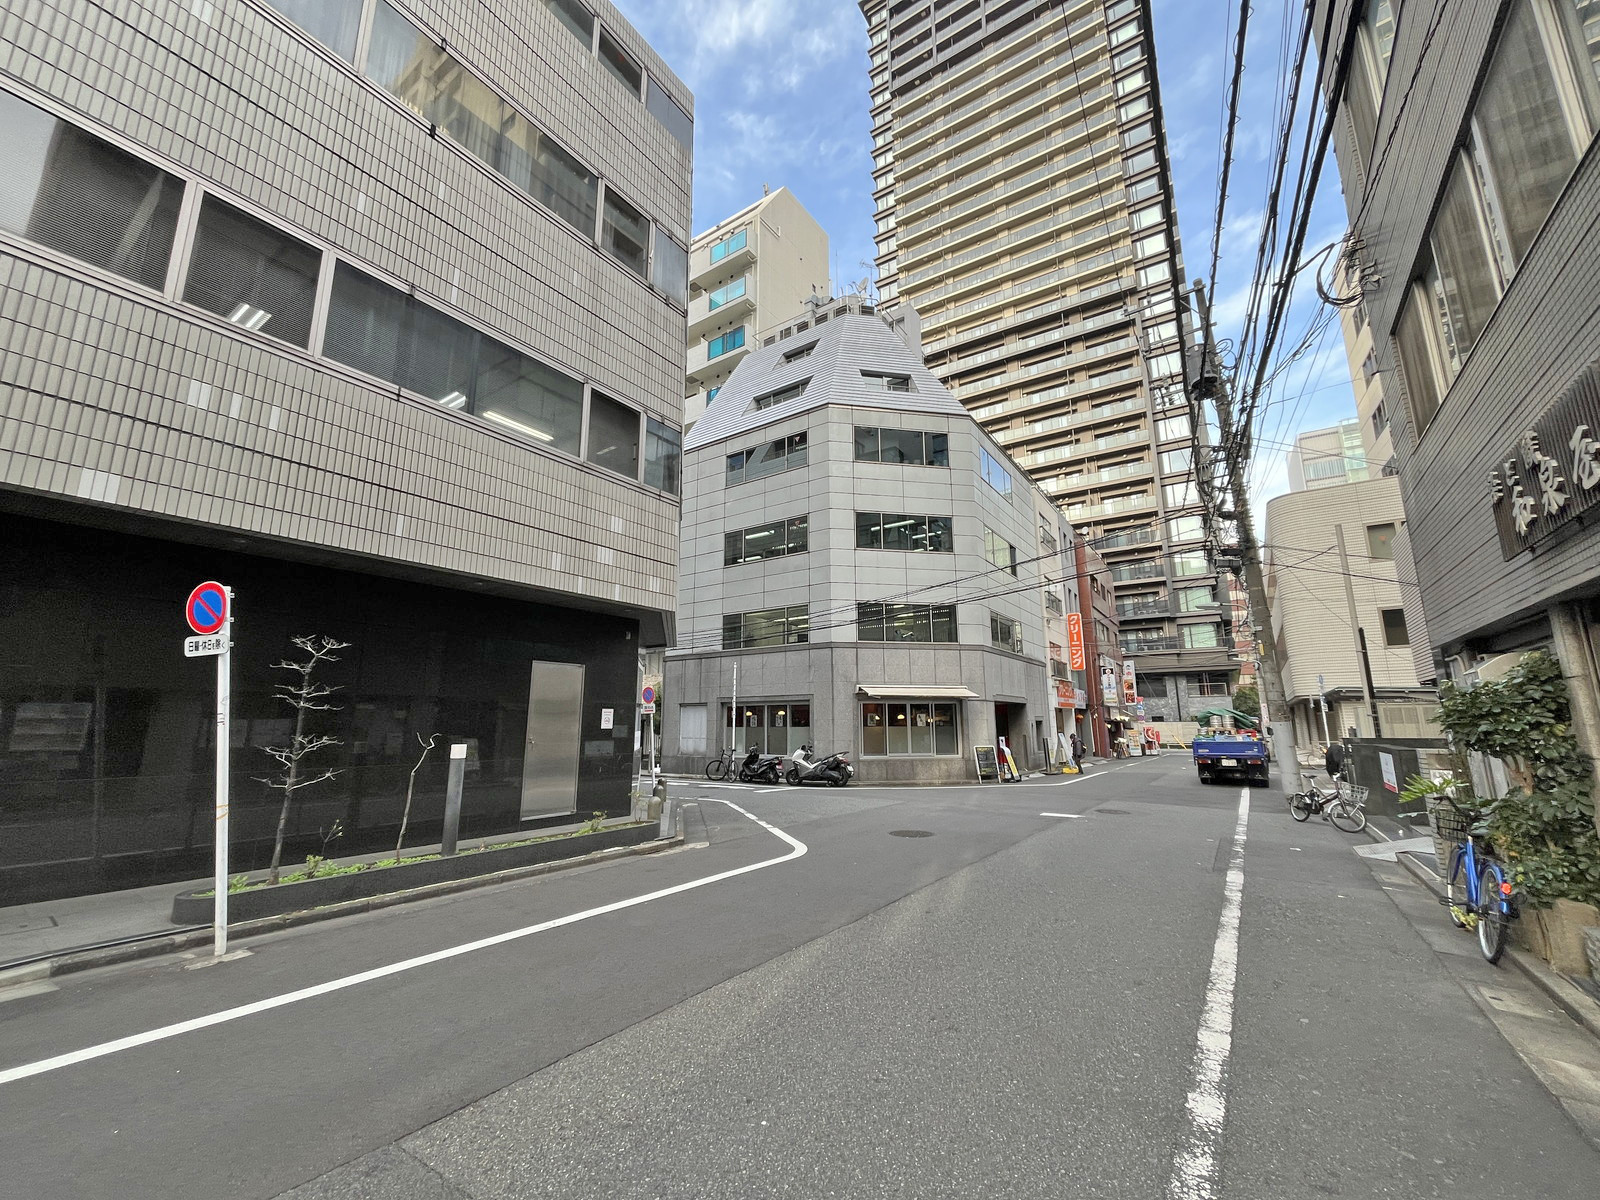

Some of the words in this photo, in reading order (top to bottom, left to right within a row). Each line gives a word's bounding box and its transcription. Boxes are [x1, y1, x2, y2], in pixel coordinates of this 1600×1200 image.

[1069, 615, 1082, 668] クリーニング
